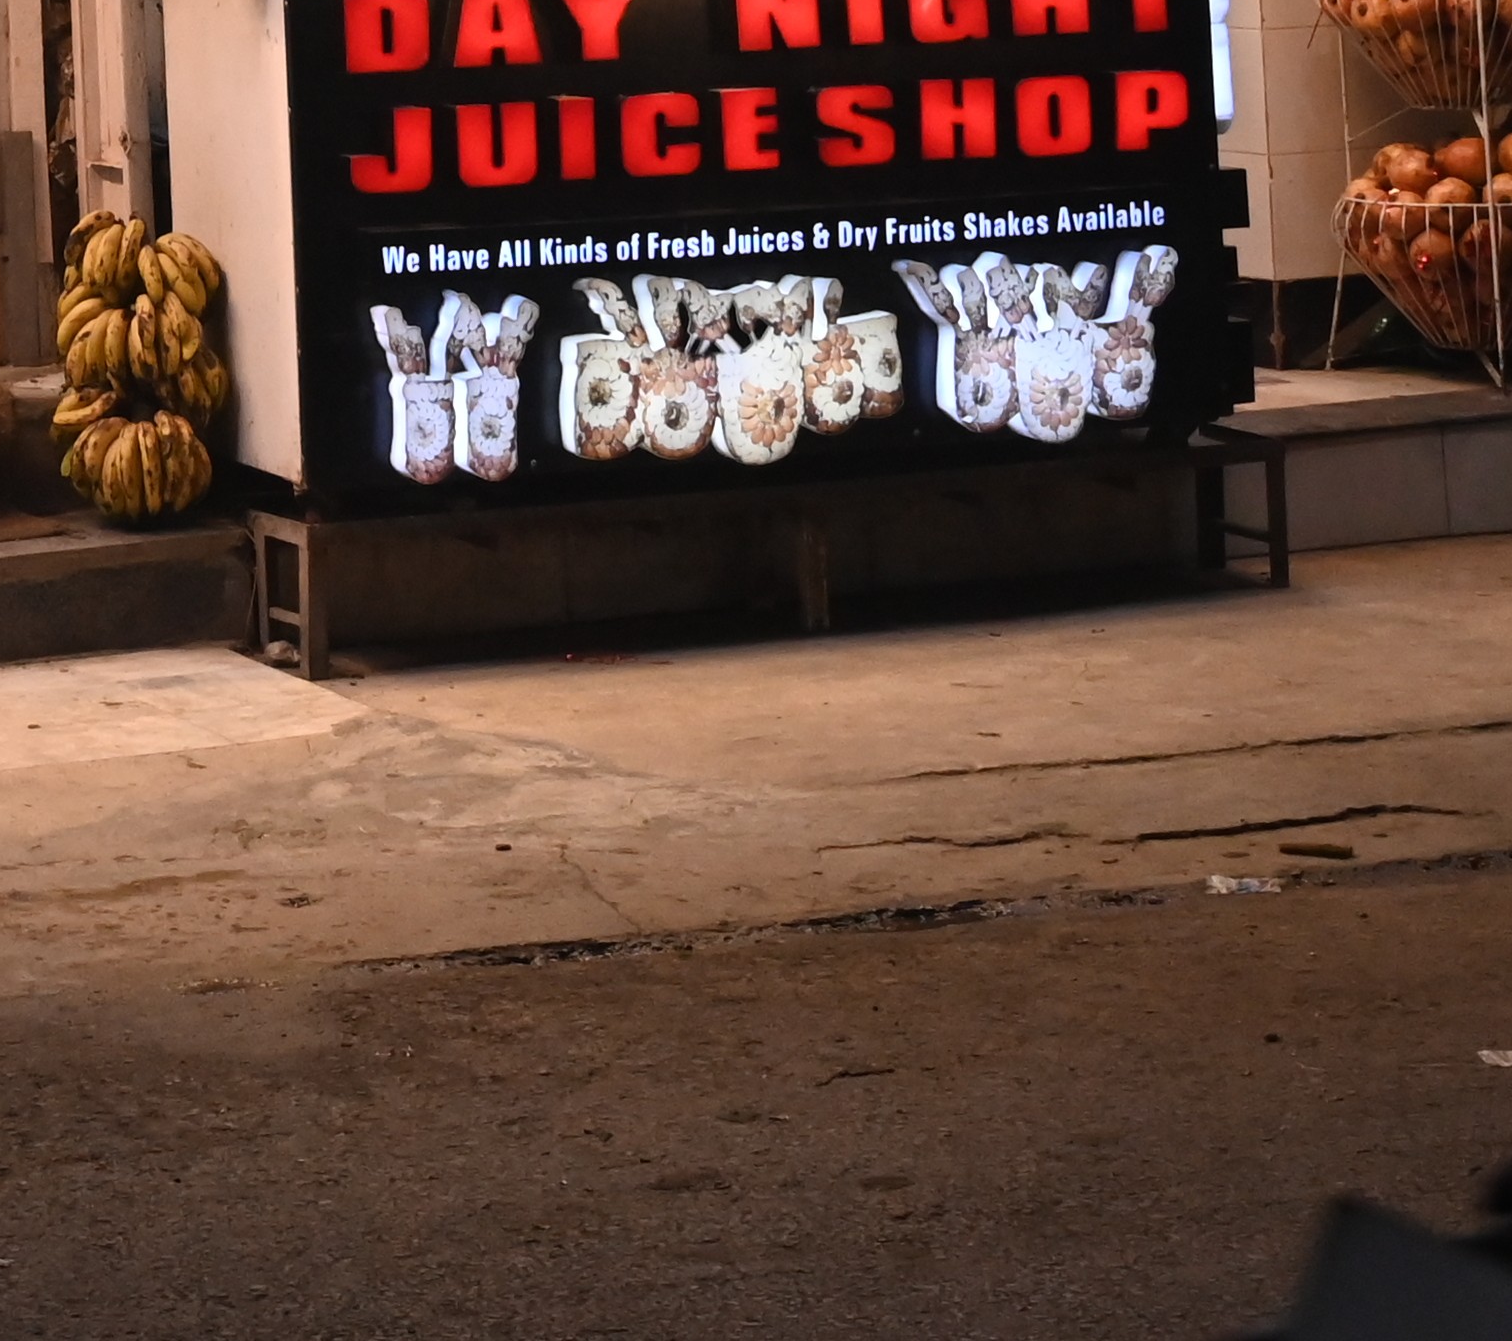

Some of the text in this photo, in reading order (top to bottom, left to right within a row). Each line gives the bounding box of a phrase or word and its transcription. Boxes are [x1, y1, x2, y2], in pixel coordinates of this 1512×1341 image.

[349, 69, 1189, 195] JUICE SHOP
[382, 245, 420, 274] We
[428, 243, 490, 273] Have
[498, 239, 531, 269] All
[539, 235, 608, 266] Kinds
[616, 232, 640, 262] of
[722, 225, 805, 256] Juices
[812, 221, 830, 250] &
[837, 219, 877, 252] Dry
[884, 214, 956, 245] Fruits
[962, 209, 1050, 241] Shakes
[1056, 200, 1166, 234] Available
